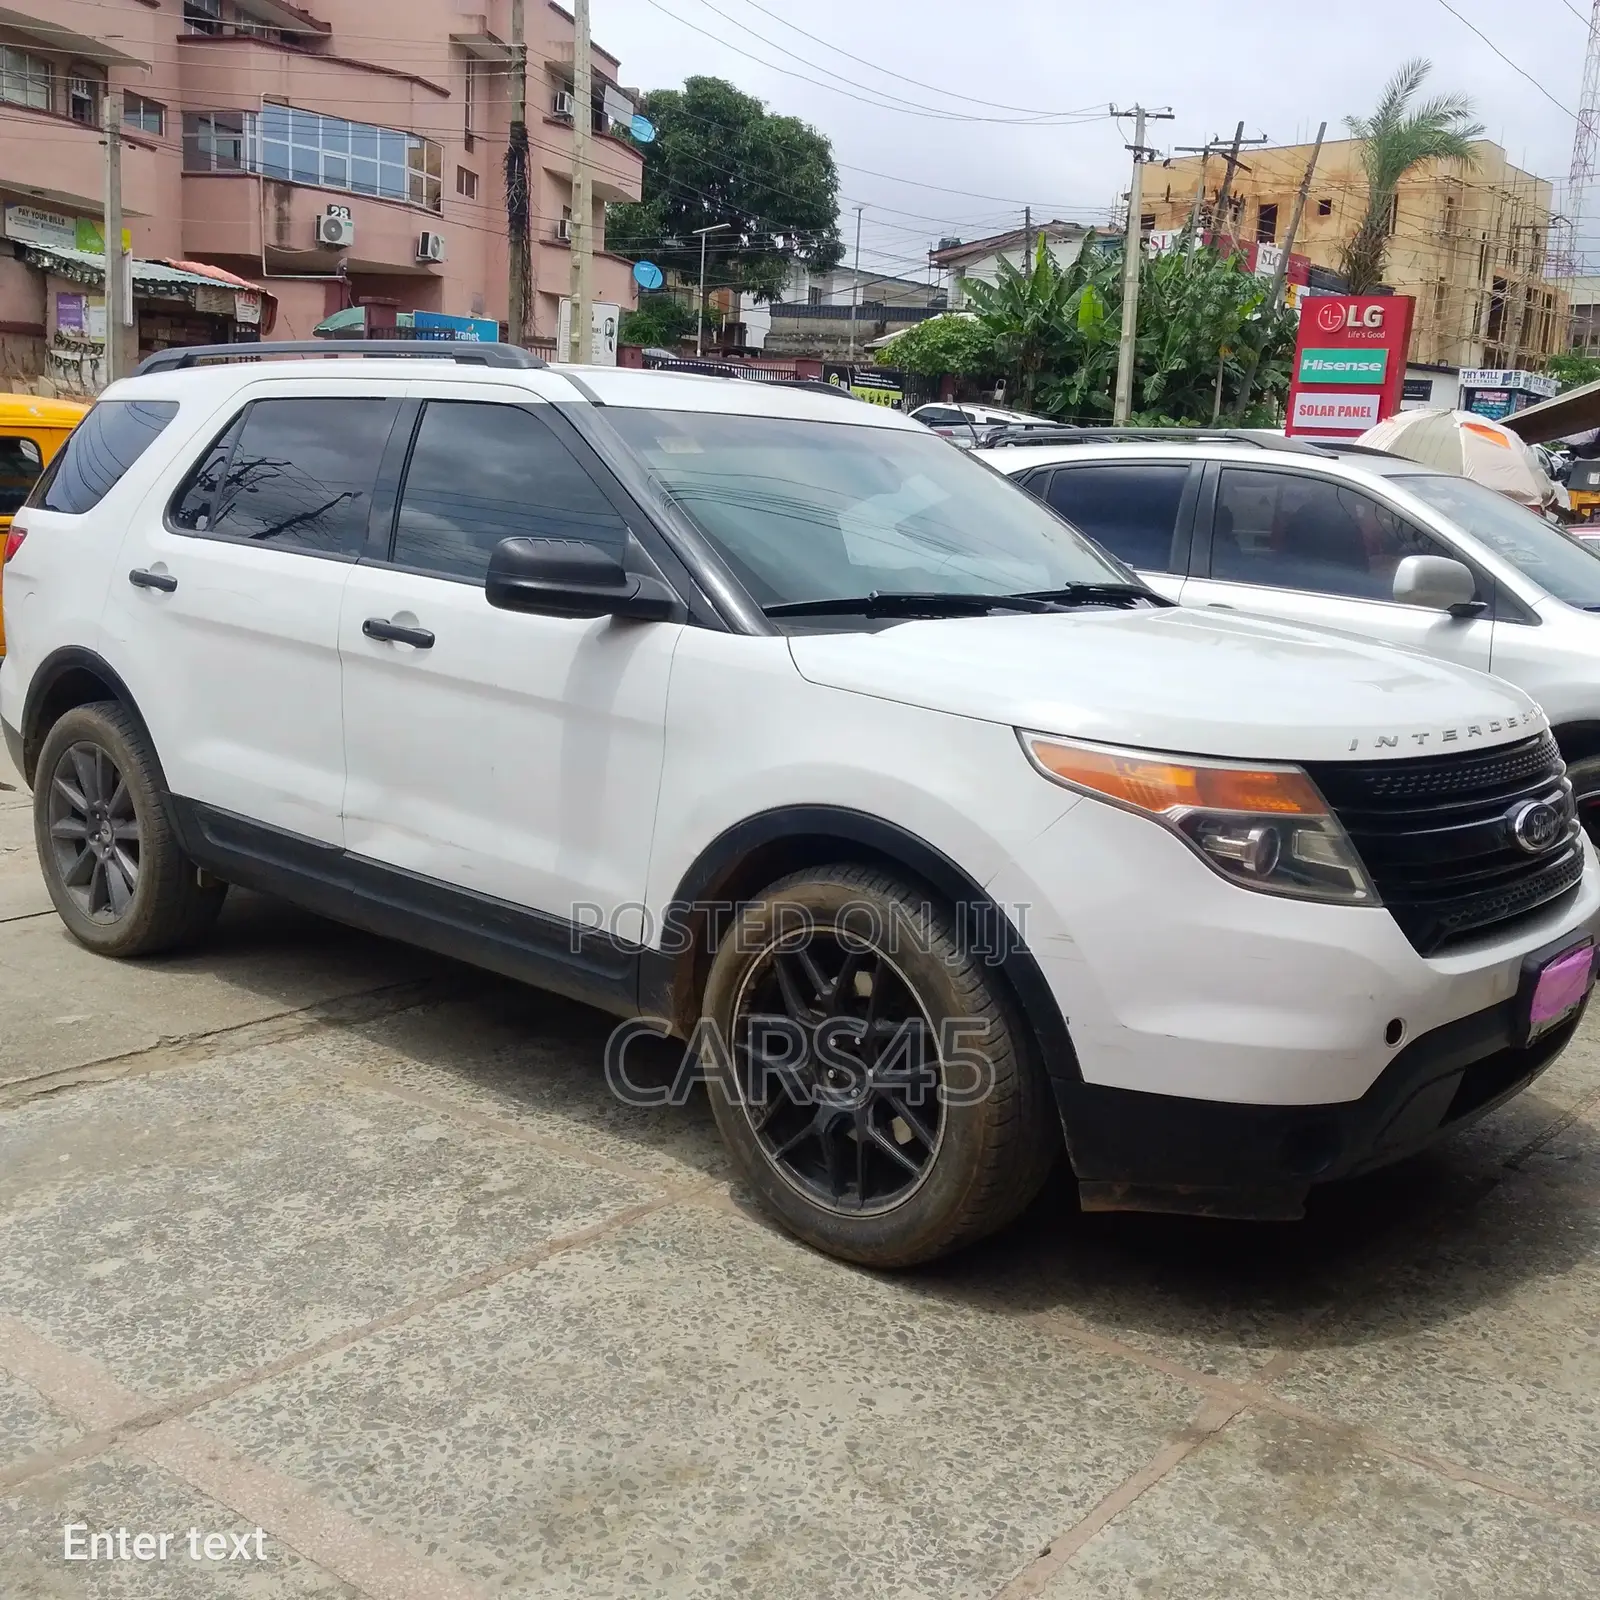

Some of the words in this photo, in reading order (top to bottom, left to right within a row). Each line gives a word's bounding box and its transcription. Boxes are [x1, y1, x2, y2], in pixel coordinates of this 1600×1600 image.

[18, 208, 30, 217] PAY
[32, 211, 48, 222] YOUR
[49, 214, 65, 226] BILLS
[331, 206, 349, 220] 28
[1346, 305, 1385, 328] LG
[1348, 331, 1366, 339] Life's
[1302, 359, 1382, 372] Hisense
[1461, 371, 1478, 380] THY
[1479, 371, 1499, 380] WILL
[1299, 404, 1336, 417] SOLAR
[1337, 406, 1372, 418] PANEL
